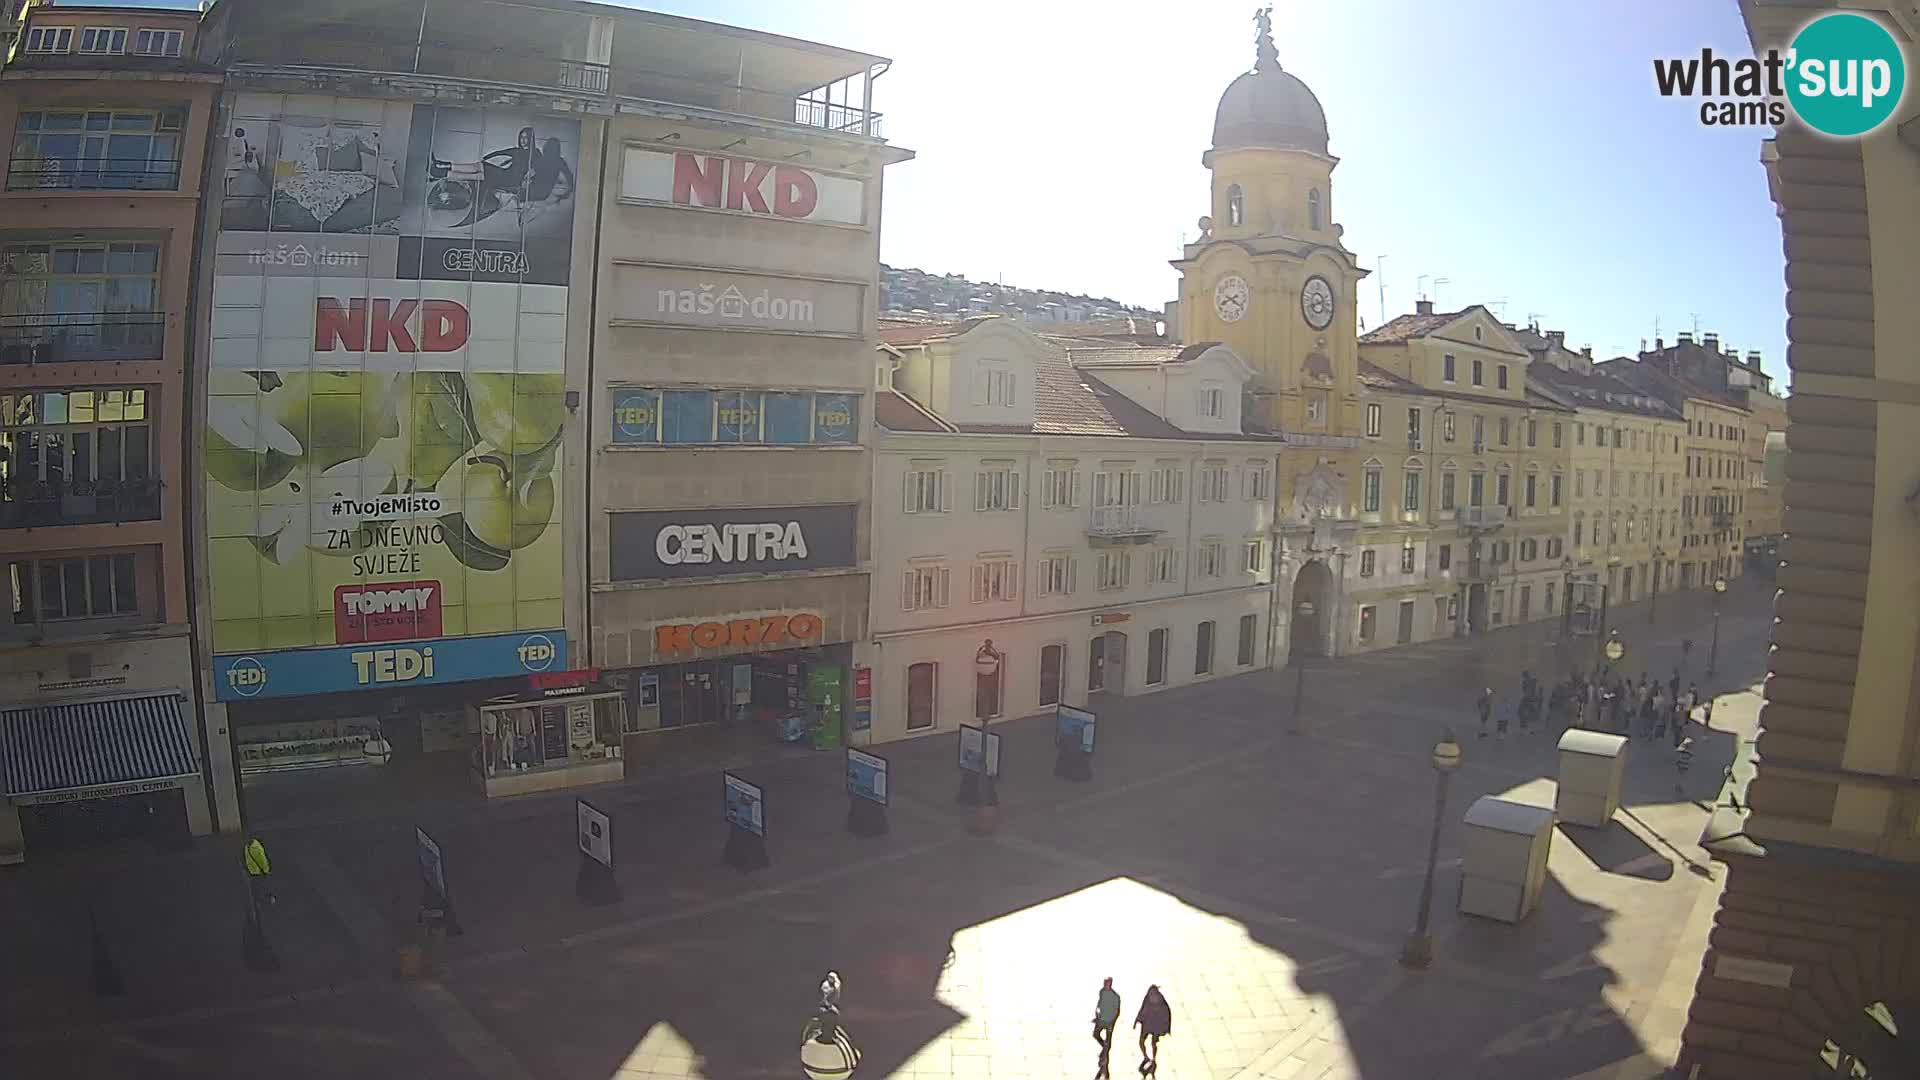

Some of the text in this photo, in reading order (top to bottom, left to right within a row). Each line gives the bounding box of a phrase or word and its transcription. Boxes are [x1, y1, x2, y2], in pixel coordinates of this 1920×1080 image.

[673, 149, 818, 218] NKD
[248, 244, 360, 266] naš dom
[443, 248, 530, 274] CENTRA
[657, 284, 814, 321] naš dom
[314, 297, 472, 352] NKD
[615, 408, 655, 425] TEDi
[332, 497, 441, 517] #TvojeMisto
[327, 524, 445, 549] ZA DNEVNO
[656, 521, 808, 565] CENTRA
[353, 548, 421, 576] SVJEŽE
[342, 587, 434, 616] TOMMY
[655, 612, 823, 655] KORZO
[351, 646, 435, 684] TEDi
[517, 643, 556, 661] TEDi
[226, 667, 267, 686] TEDi
